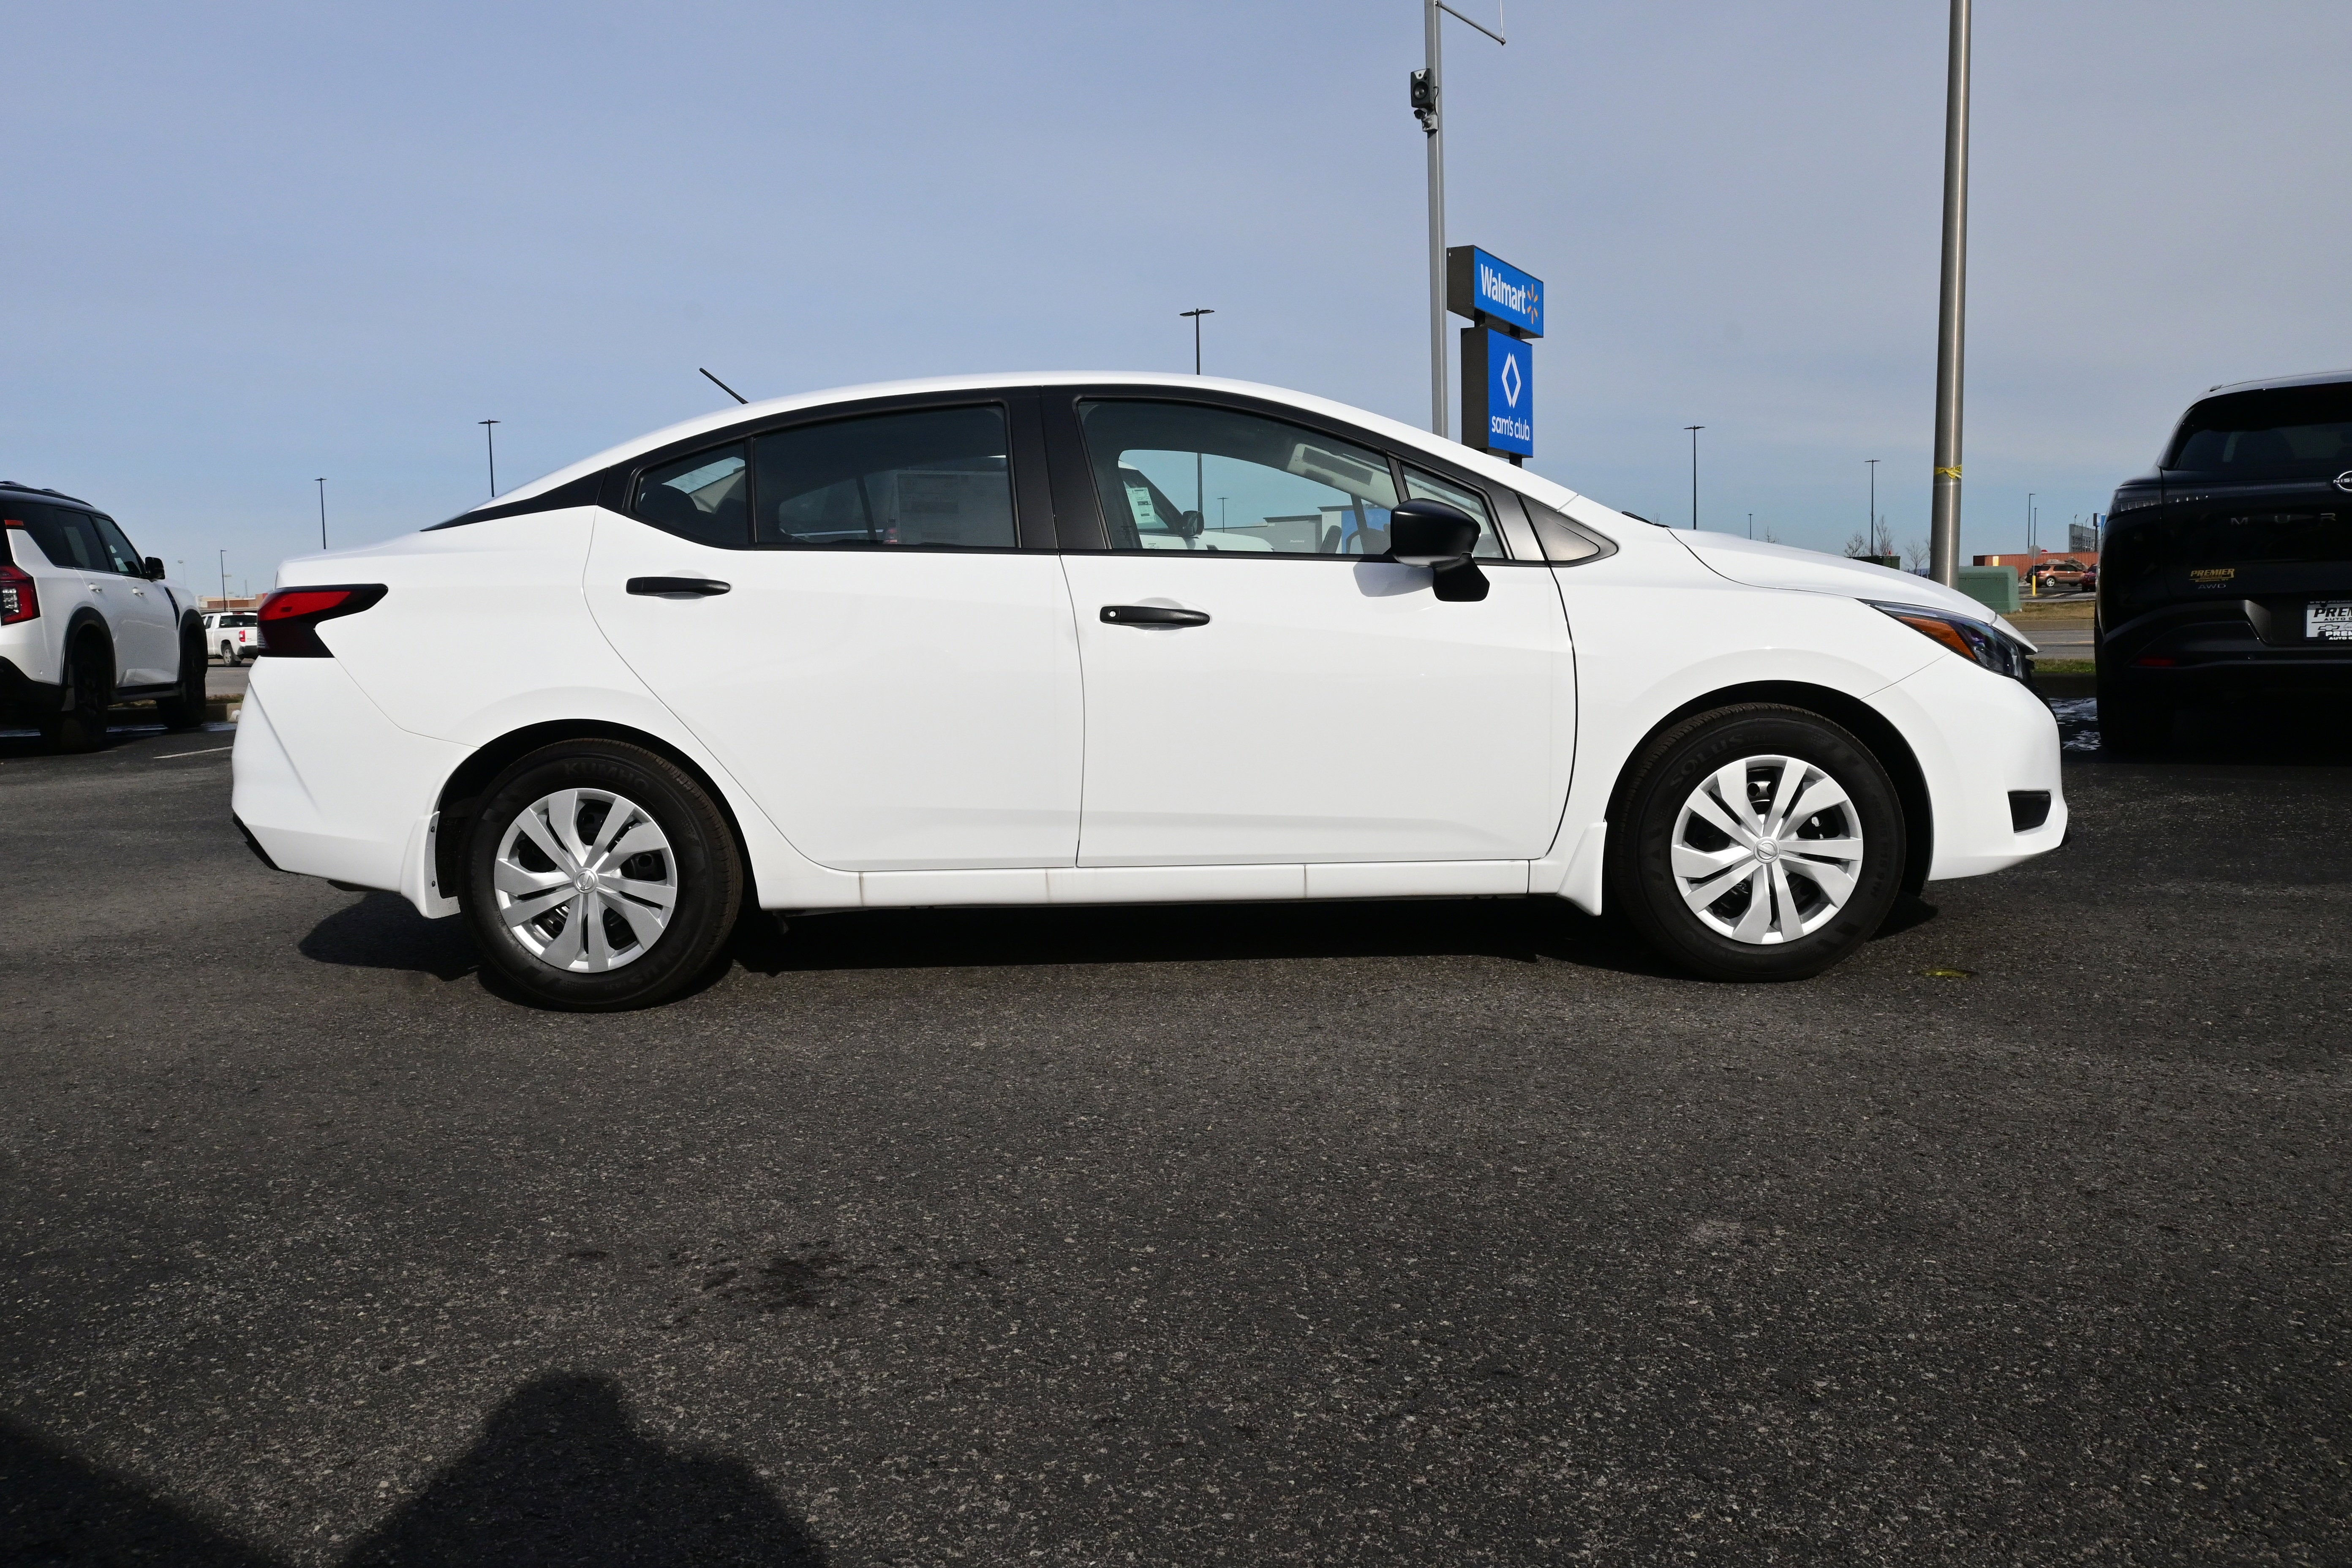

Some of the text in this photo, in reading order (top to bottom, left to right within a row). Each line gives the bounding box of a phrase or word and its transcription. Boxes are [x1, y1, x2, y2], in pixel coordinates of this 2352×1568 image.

[1481, 263, 1525, 314] Walmart
[1492, 416, 1530, 441] sam's club
[2191, 569, 2235, 577] PREMIER
[1670, 734, 1743, 789] SOLUS
[565, 762, 649, 789] KUMHO
